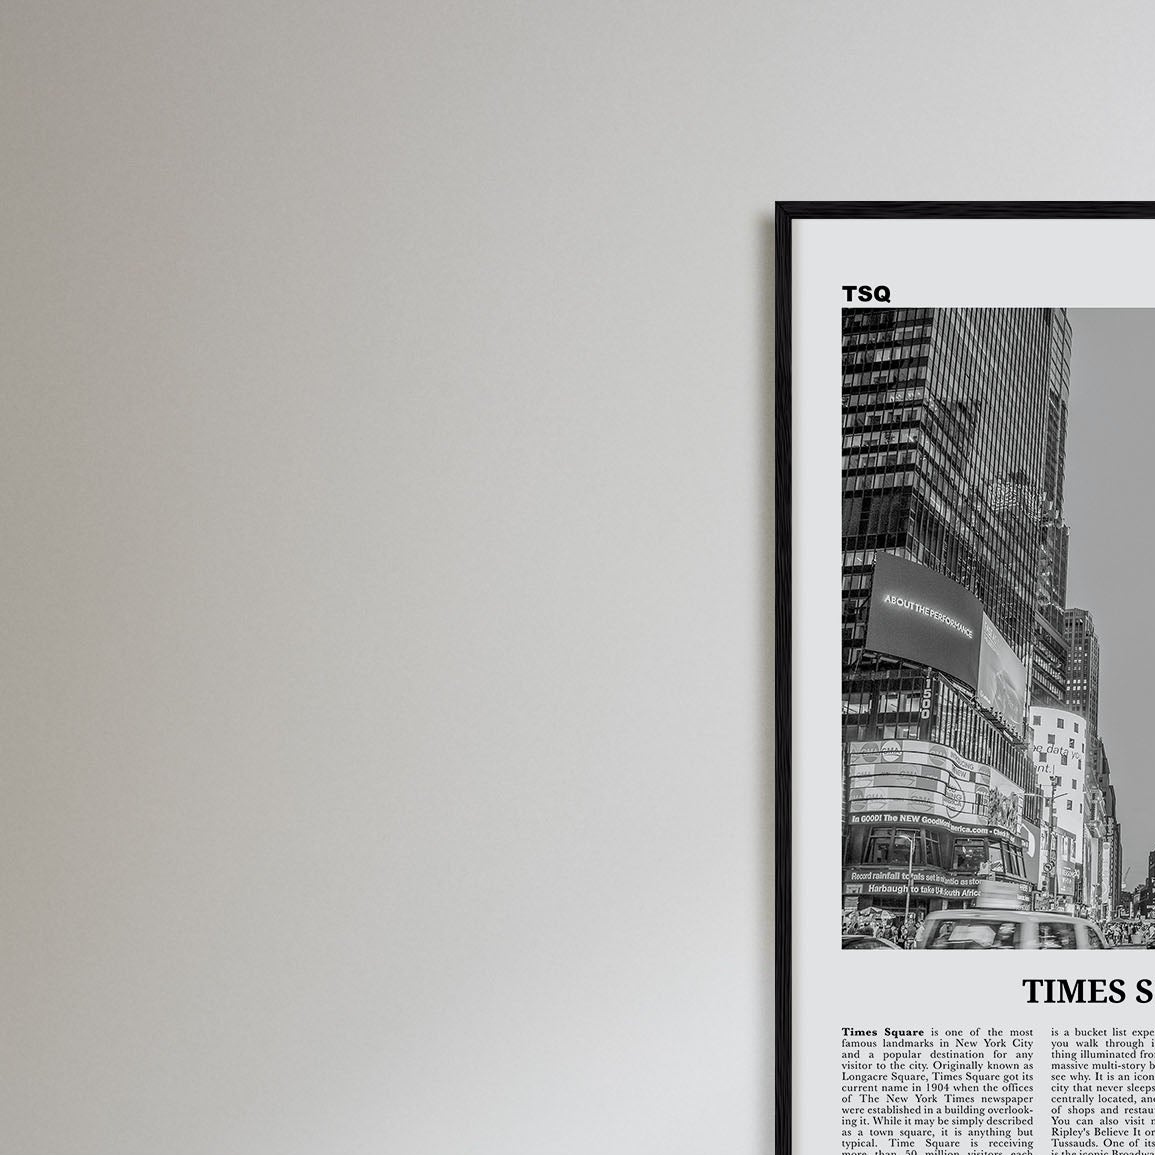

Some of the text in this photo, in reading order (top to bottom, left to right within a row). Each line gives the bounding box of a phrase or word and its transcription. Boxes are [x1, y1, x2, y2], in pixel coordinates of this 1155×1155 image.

[842, 285, 891, 303] TSQ
[884, 594, 914, 610] ABOUT
[915, 604, 930, 616] THE
[930, 610, 974, 639] PERFORMANCE
[921, 678, 932, 719] 1500
[1046, 744, 1069, 756] data
[884, 814, 898, 822] The
[900, 814, 920, 823] NEW
[872, 872, 900, 880] rainfall
[868, 884, 908, 893] Harbaugh
[1023, 979, 1125, 1003] TIMES
[841, 1028, 878, 1036] Times
[884, 1028, 924, 1039] Square
[931, 1028, 939, 1036] is
[969, 1028, 981, 1036] of
[988, 1028, 1003, 1036] the
[1010, 1028, 1033, 1036] most
[1051, 1028, 1059, 1036] is
[1074, 1028, 1107, 1036] bucket
[1112, 1028, 1127, 1036] list
[842, 1072, 1034, 1083] Longacre Square, Times Square got its
[1051, 1095, 1094, 1105] centrally
[1098, 1095, 1137, 1105] located,
[842, 1117, 1033, 1127] ing it. While it may be simply described
